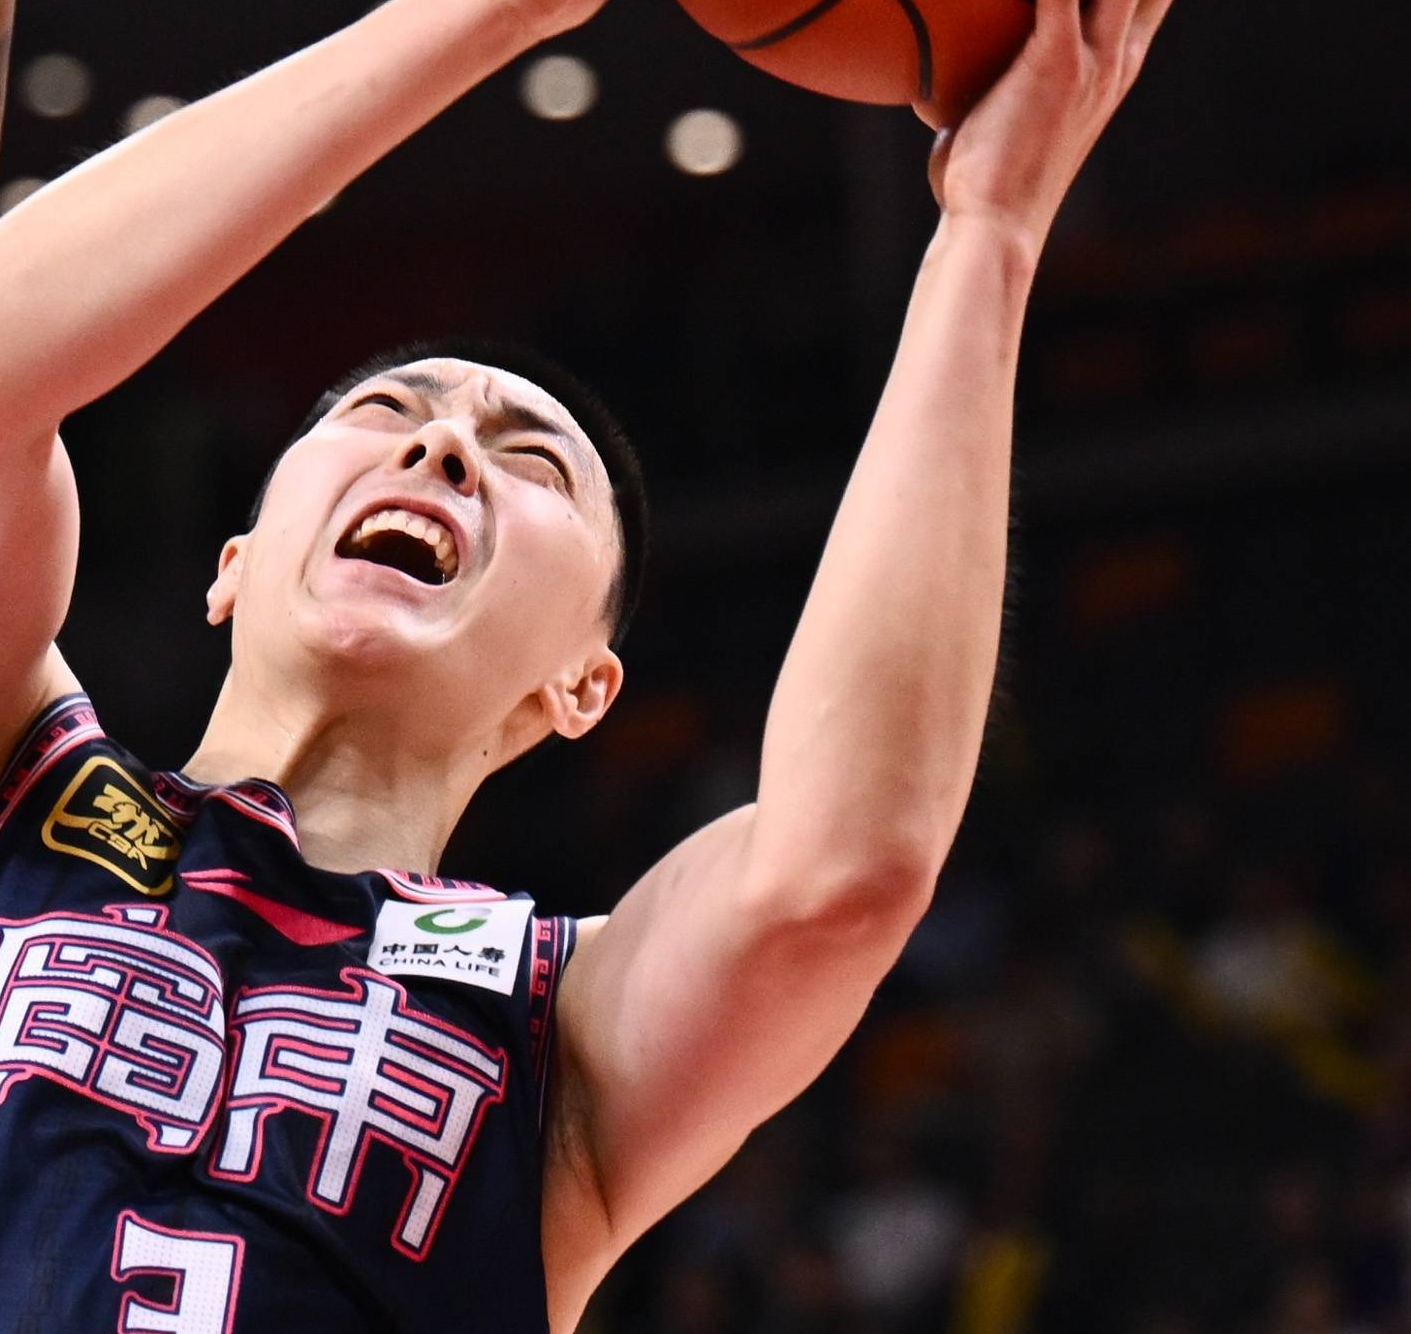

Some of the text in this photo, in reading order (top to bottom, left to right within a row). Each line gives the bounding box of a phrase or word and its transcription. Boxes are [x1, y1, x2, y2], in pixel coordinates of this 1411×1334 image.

[87, 820, 149, 872] CBA
[381, 942, 506, 964] 中国人寿
[378, 957, 501, 979] CHINA LIFE
